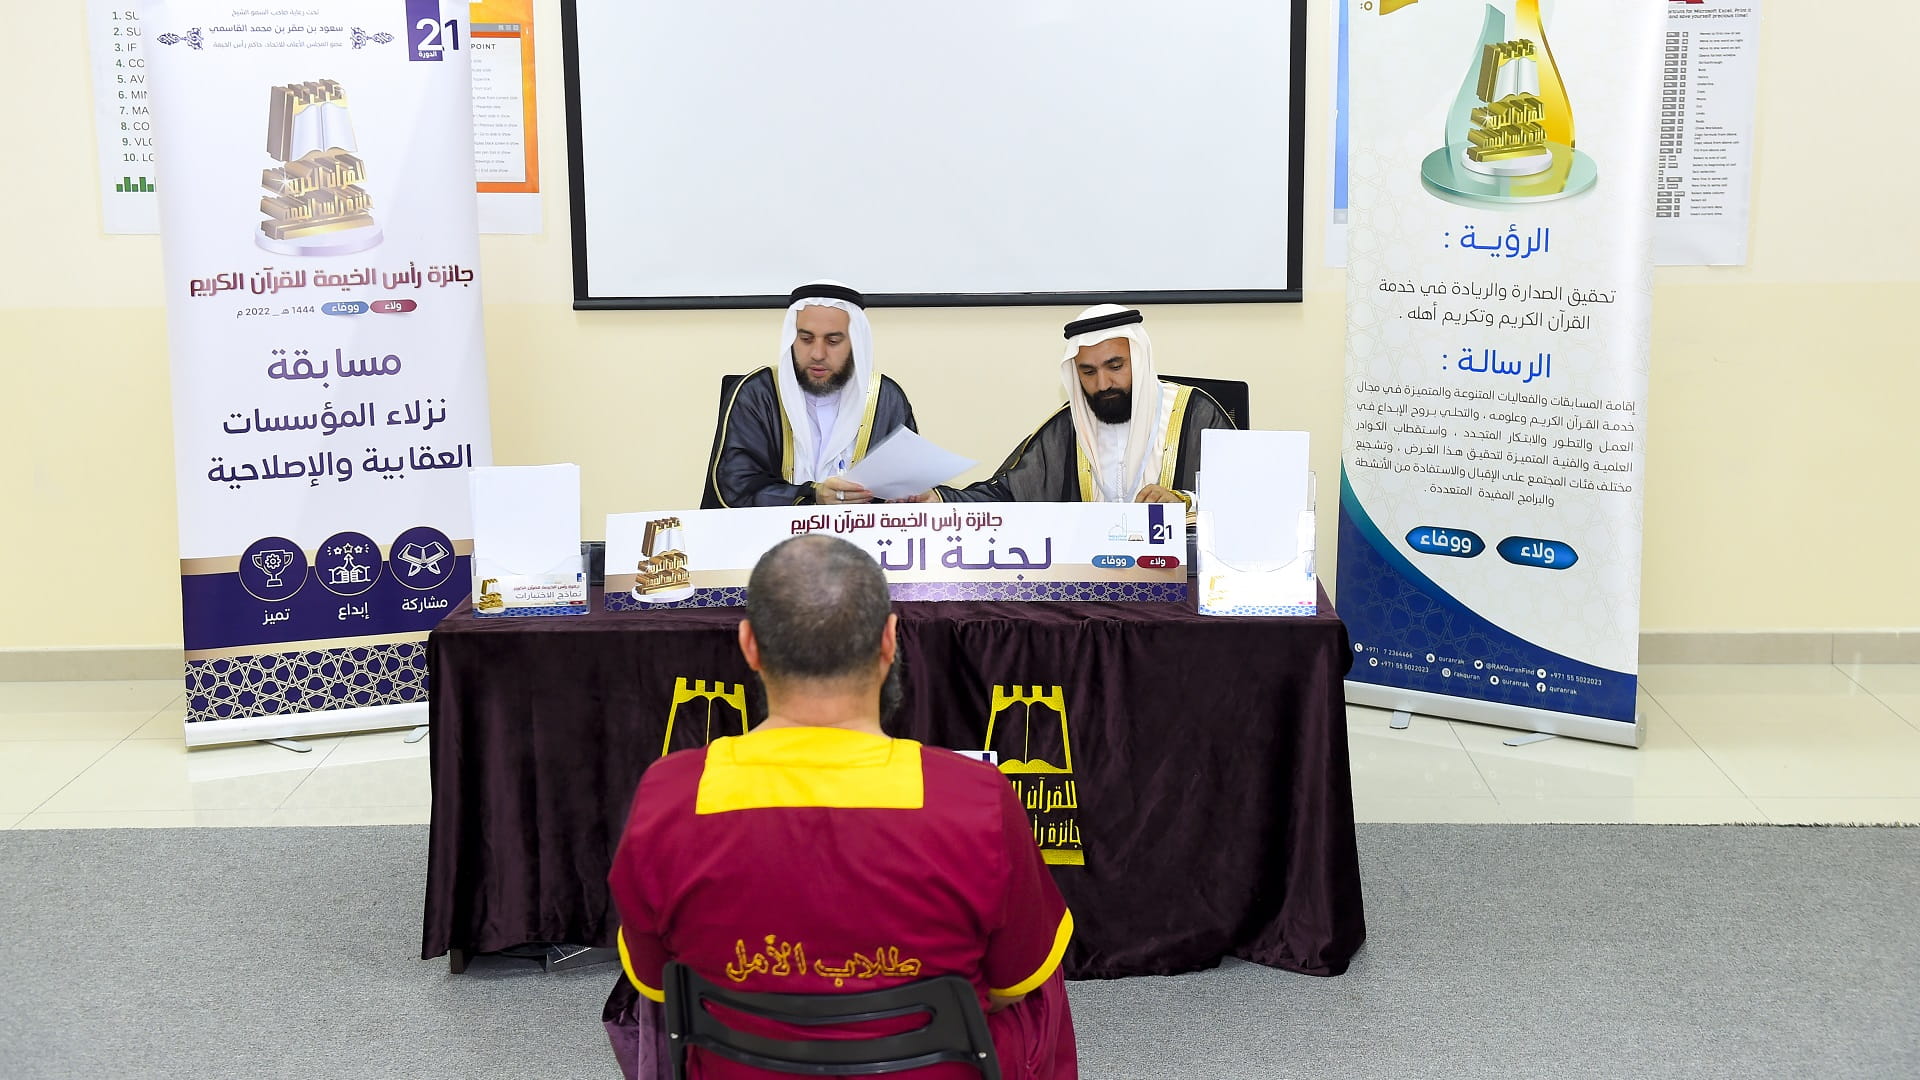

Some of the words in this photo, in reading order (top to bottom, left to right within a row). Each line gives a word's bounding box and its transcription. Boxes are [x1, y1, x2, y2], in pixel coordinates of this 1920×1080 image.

[113, 27, 122, 36] 2.
[209, 24, 247, 34] القاسمي
[275, 25, 285, 34] بن
[288, 24, 304, 34] صقر
[306, 25, 316, 34] بن
[319, 25, 343, 34] سعود
[416, 18, 459, 51] 21
[114, 43, 123, 52] 3.
[127, 43, 136, 52] IF
[116, 59, 125, 68] 4.
[117, 75, 126, 83] 5.
[118, 91, 127, 99] 6.
[120, 106, 128, 115] 7.
[132, 106, 149, 115] MA
[121, 122, 130, 131] 8.
[133, 122, 150, 131] CO
[122, 137, 131, 146] 9.
[123, 153, 139, 162] 10.
[251, 267, 306, 295] للقرآن
[313, 267, 376, 291] الخيمة
[383, 261, 422, 289] رأس
[427, 264, 474, 288] جائزة
[190, 272, 244, 297] الكريم
[1379, 278, 1415, 294] خدمة
[1420, 281, 1447, 297] في
[1451, 281, 1507, 300] والريادة
[1511, 283, 1562, 302] الصدارة
[1567, 289, 1616, 307] تحقيق
[245, 308, 270, 316] 2022
[292, 306, 315, 314] 1444
[332, 302, 360, 312] ووفاء
[384, 302, 402, 311] ولاء
[1407, 302, 1437, 321] أهله
[1441, 308, 1494, 326] وتكريم
[1499, 311, 1543, 329] الكريم
[1548, 309, 1590, 332] القرآن
[267, 348, 402, 389] مسابقة
[1458, 348, 1551, 383] الرسالة
[1356, 381, 1380, 394] مجال
[1382, 384, 1402, 394] في
[1404, 386, 1451, 399] والمتميزة
[1454, 389, 1495, 401] المتنوعة
[1497, 392, 1548, 407] والفعاليات
[1356, 402, 1375, 412] في
[1377, 402, 1408, 416] الإبداع
[1550, 395, 1603, 410] المسابقات
[1605, 400, 1635, 415] إقامة
[223, 401, 375, 436] المؤسسات
[386, 398, 447, 431] نزلاء
[1411, 407, 1437, 418] بروح
[1439, 407, 1480, 421] والتحلي
[1489, 412, 1527, 425] وعلومه
[1355, 420, 1387, 432] الكوادر
[1529, 416, 1564, 428] الكريم
[1566, 415, 1599, 430] القرآن
[1393, 423, 1447, 438] واستقطاب
[1464, 430, 1502, 442] المتجدد
[1507, 431, 1547, 447] والابتكار
[1553, 437, 1593, 451] والتطور
[1355, 440, 1393, 453] وتشجيع
[1404, 443, 1439, 456] الغرض
[1443, 445, 1463, 457] هذا
[1599, 441, 1634, 454] العمل
[362, 443, 472, 480] العقابية
[1466, 449, 1503, 460] لتحقيق
[1506, 453, 1549, 465] المتميزة
[1355, 456, 1392, 470] الأنشطة
[1394, 463, 1411, 474] من
[1552, 456, 1589, 471] والفنية
[1593, 461, 1633, 474] العلمية
[207, 451, 353, 490] والإصلاحية
[1413, 463, 1466, 479] والاستفادة
[1467, 467, 1500, 482] الإقبال
[1502, 471, 1524, 483] على
[1527, 475, 1566, 489] المجتمع
[1569, 478, 1594, 490] فئات
[1596, 480, 1632, 493] مختلف
[1430, 483, 1472, 496] المتعددة
[1478, 489, 1514, 502] المفيدة
[1517, 493, 1555, 507] والبرامج
[791, 515, 830, 534] الكريم
[834, 511, 875, 534] للقرآن
[880, 512, 927, 533] الخيمة
[932, 508, 961, 532] رأس
[966, 511, 1003, 532] جائزة
[1153, 524, 1172, 540] 21
[1420, 529, 1472, 553] ووفاء
[941, 536, 1053, 581] لجنة
[1521, 542, 1555, 564] ولاء
[1101, 556, 1127, 567] ووفاء
[1150, 557, 1166, 567] ولاء
[338, 602, 370, 620] إبداع
[402, 596, 448, 614] مشاركة
[262, 608, 290, 625] تميز
[1365, 646, 1379, 654] +971
[1550, 672, 1565, 680] +971
[1027, 776, 1078, 813] للقرآن
[1032, 813, 1044, 847] رأ
[1047, 818, 1082, 849] جائزة
[726, 934, 807, 983] الأمل
[814, 946, 922, 988] طلاب
